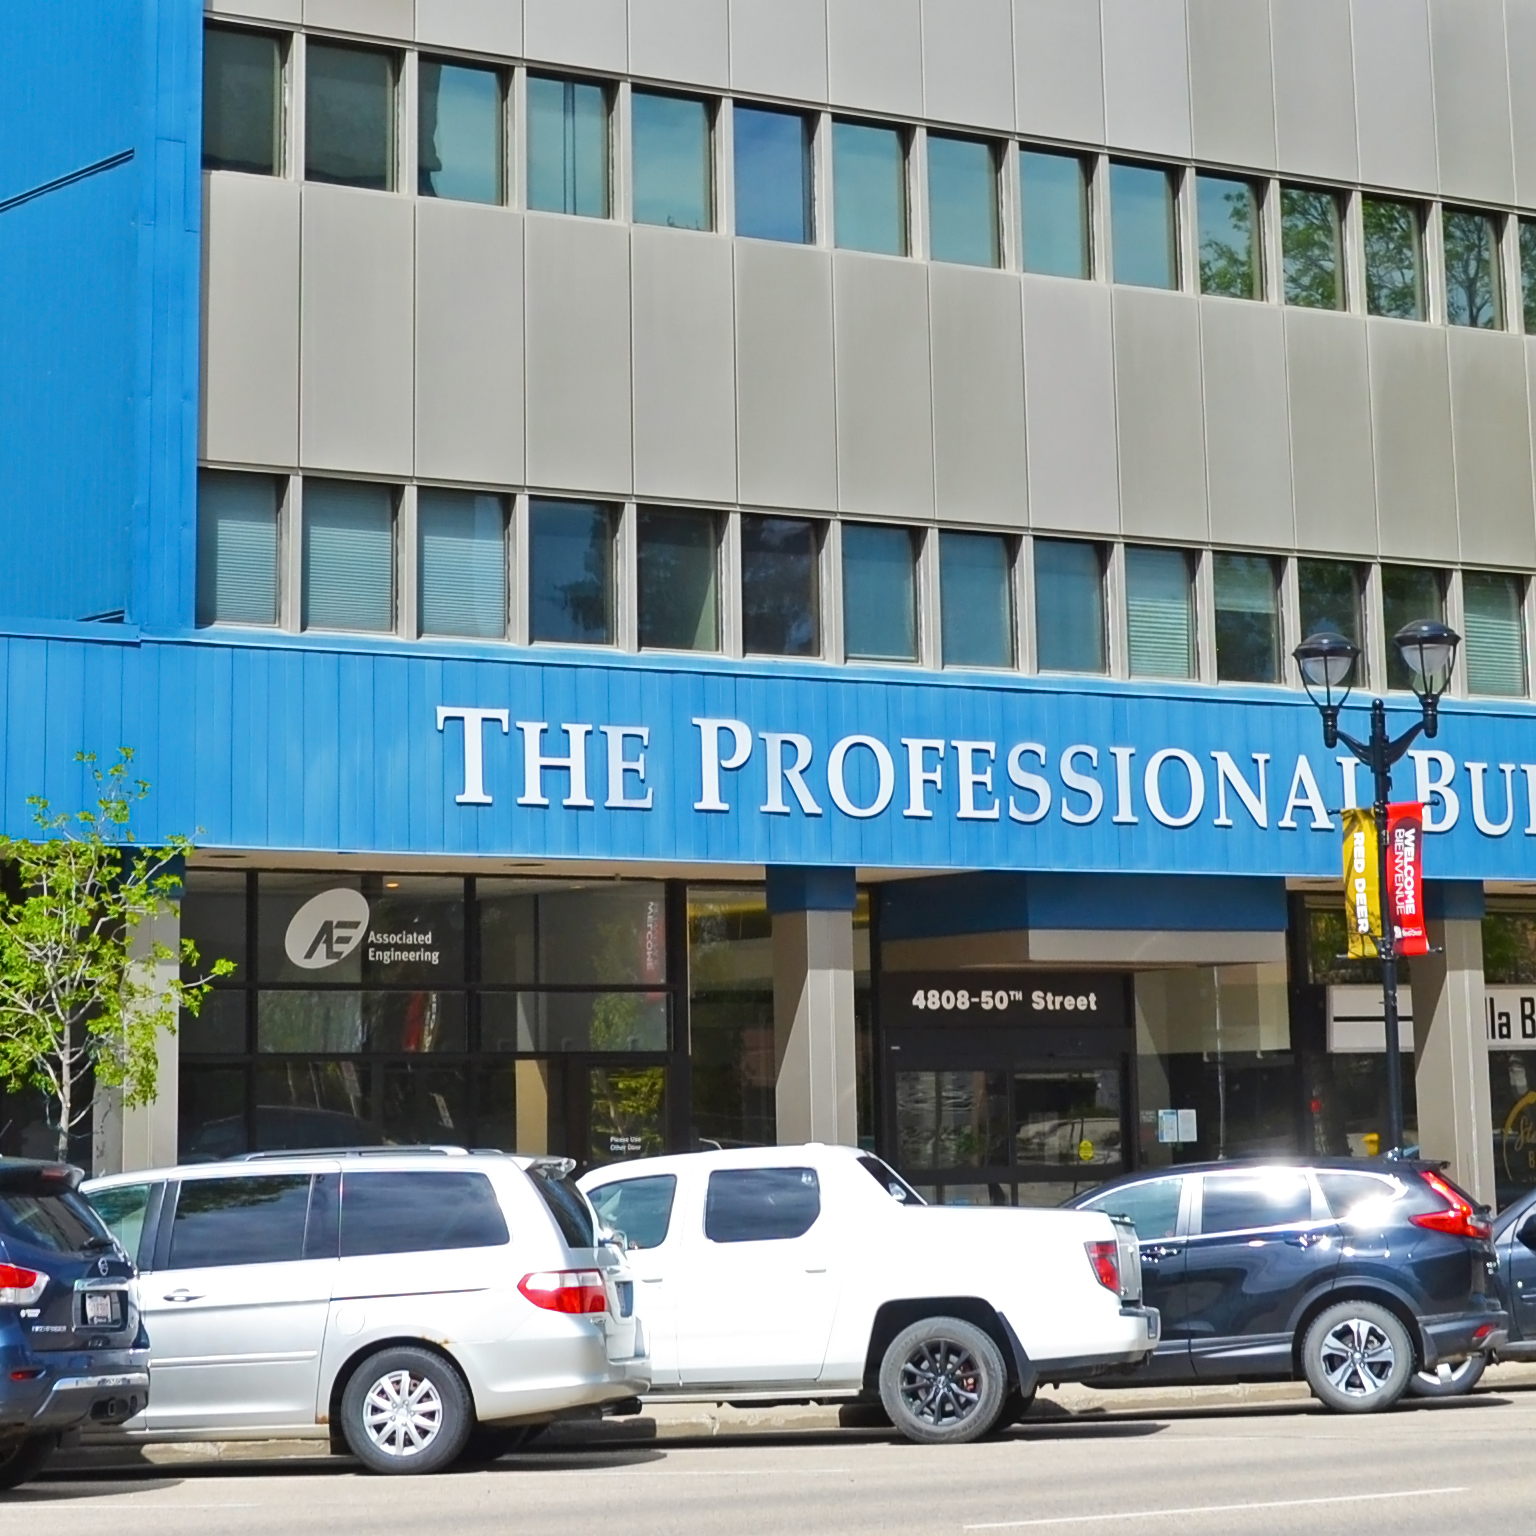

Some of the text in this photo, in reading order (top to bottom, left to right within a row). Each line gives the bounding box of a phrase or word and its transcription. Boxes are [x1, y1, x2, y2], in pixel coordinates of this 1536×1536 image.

[436, 706, 653, 810] THE
[1354, 831, 1369, 934] RED DEER
[1394, 828, 1405, 916] BIENVENUE
[1404, 828, 1416, 915] WELCOME
[368, 931, 432, 945] Associated
[368, 948, 440, 964] Engineering
[1032, 991, 1097, 1011] Street
